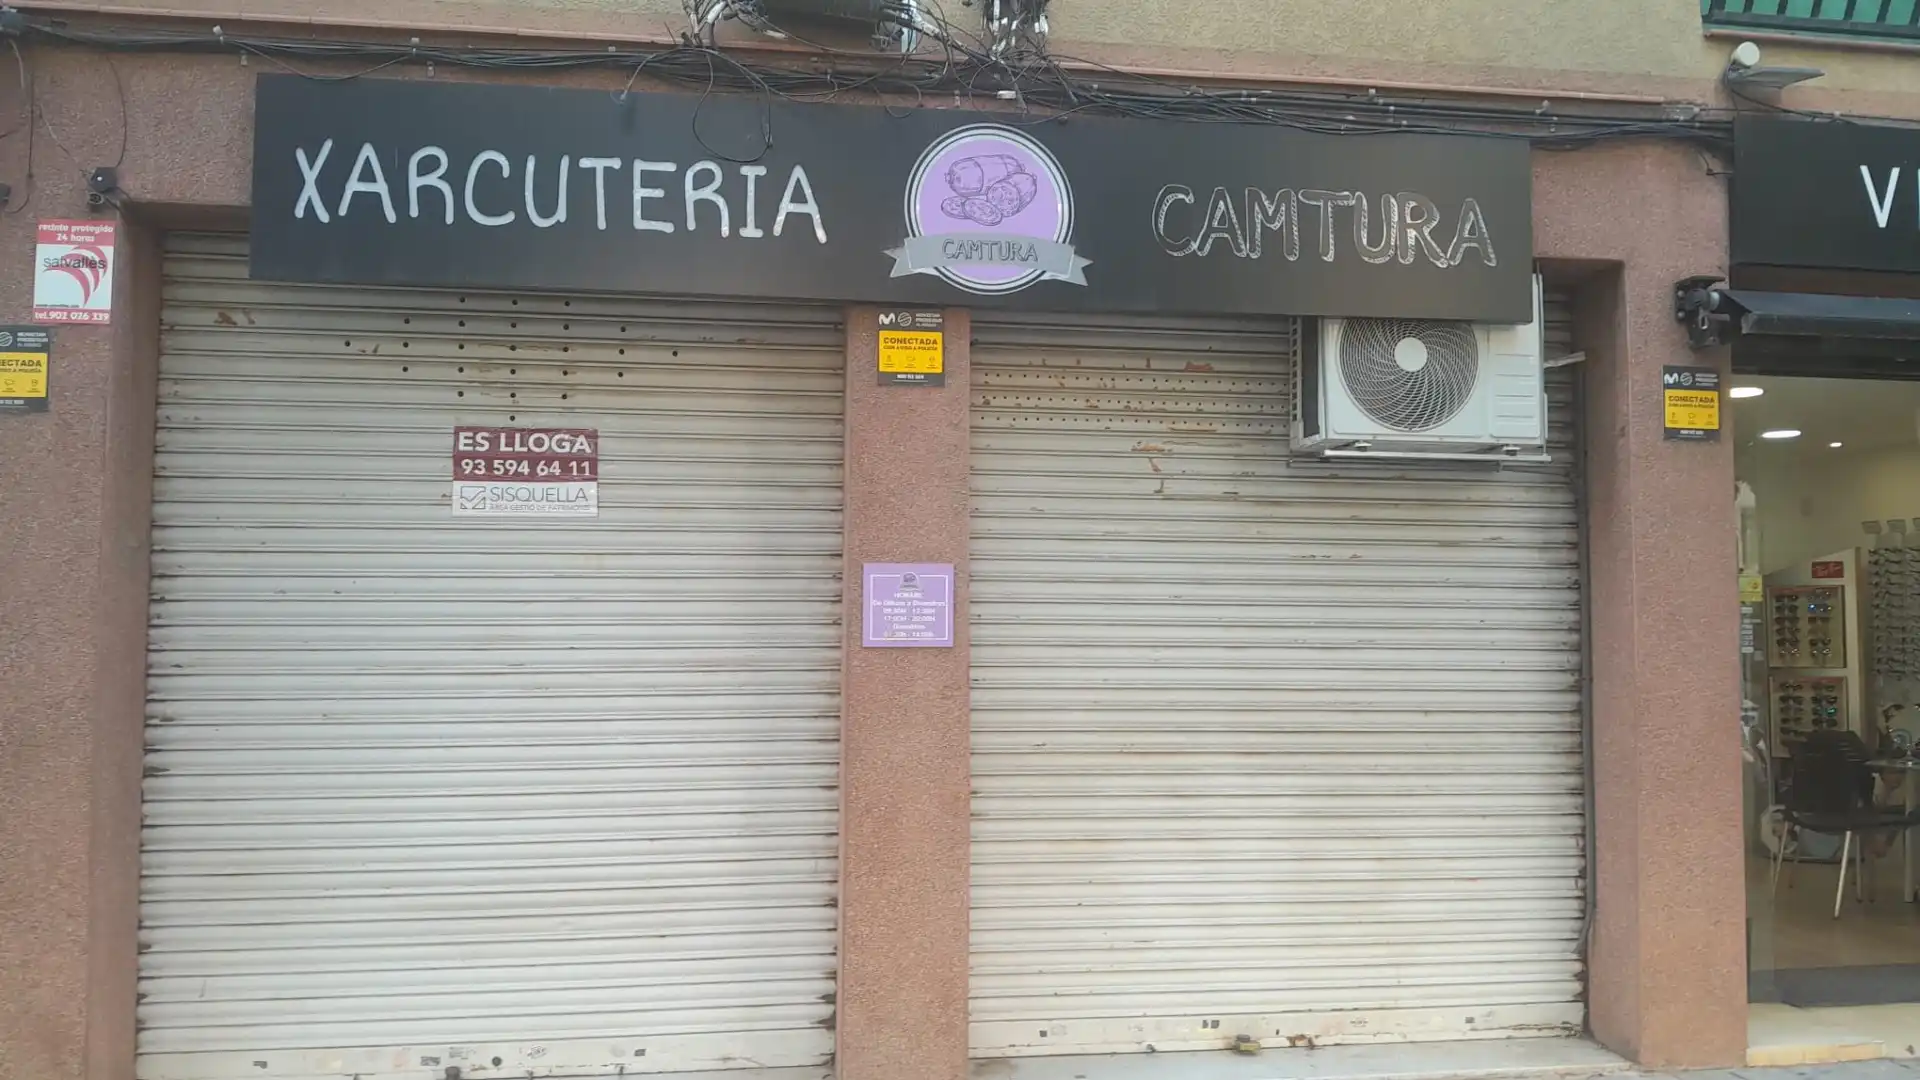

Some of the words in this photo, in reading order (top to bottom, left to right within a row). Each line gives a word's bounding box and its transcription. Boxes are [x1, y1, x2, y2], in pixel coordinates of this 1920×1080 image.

[295, 138, 828, 244] XARCUTERIA
[1860, 165, 1920, 231] V
[56, 233, 68, 241] 24
[1152, 184, 1498, 269] CAMTURA
[942, 238, 1039, 263] CAMTURA
[883, 337, 938, 345] CONECTADA
[458, 432, 490, 451] ES
[500, 433, 593, 453] LLOGA
[461, 459, 486, 475] 93
[493, 460, 530, 476] 594
[536, 461, 562, 476] 64
[569, 462, 591, 476] 11
[490, 487, 588, 503] SISQUELLA
